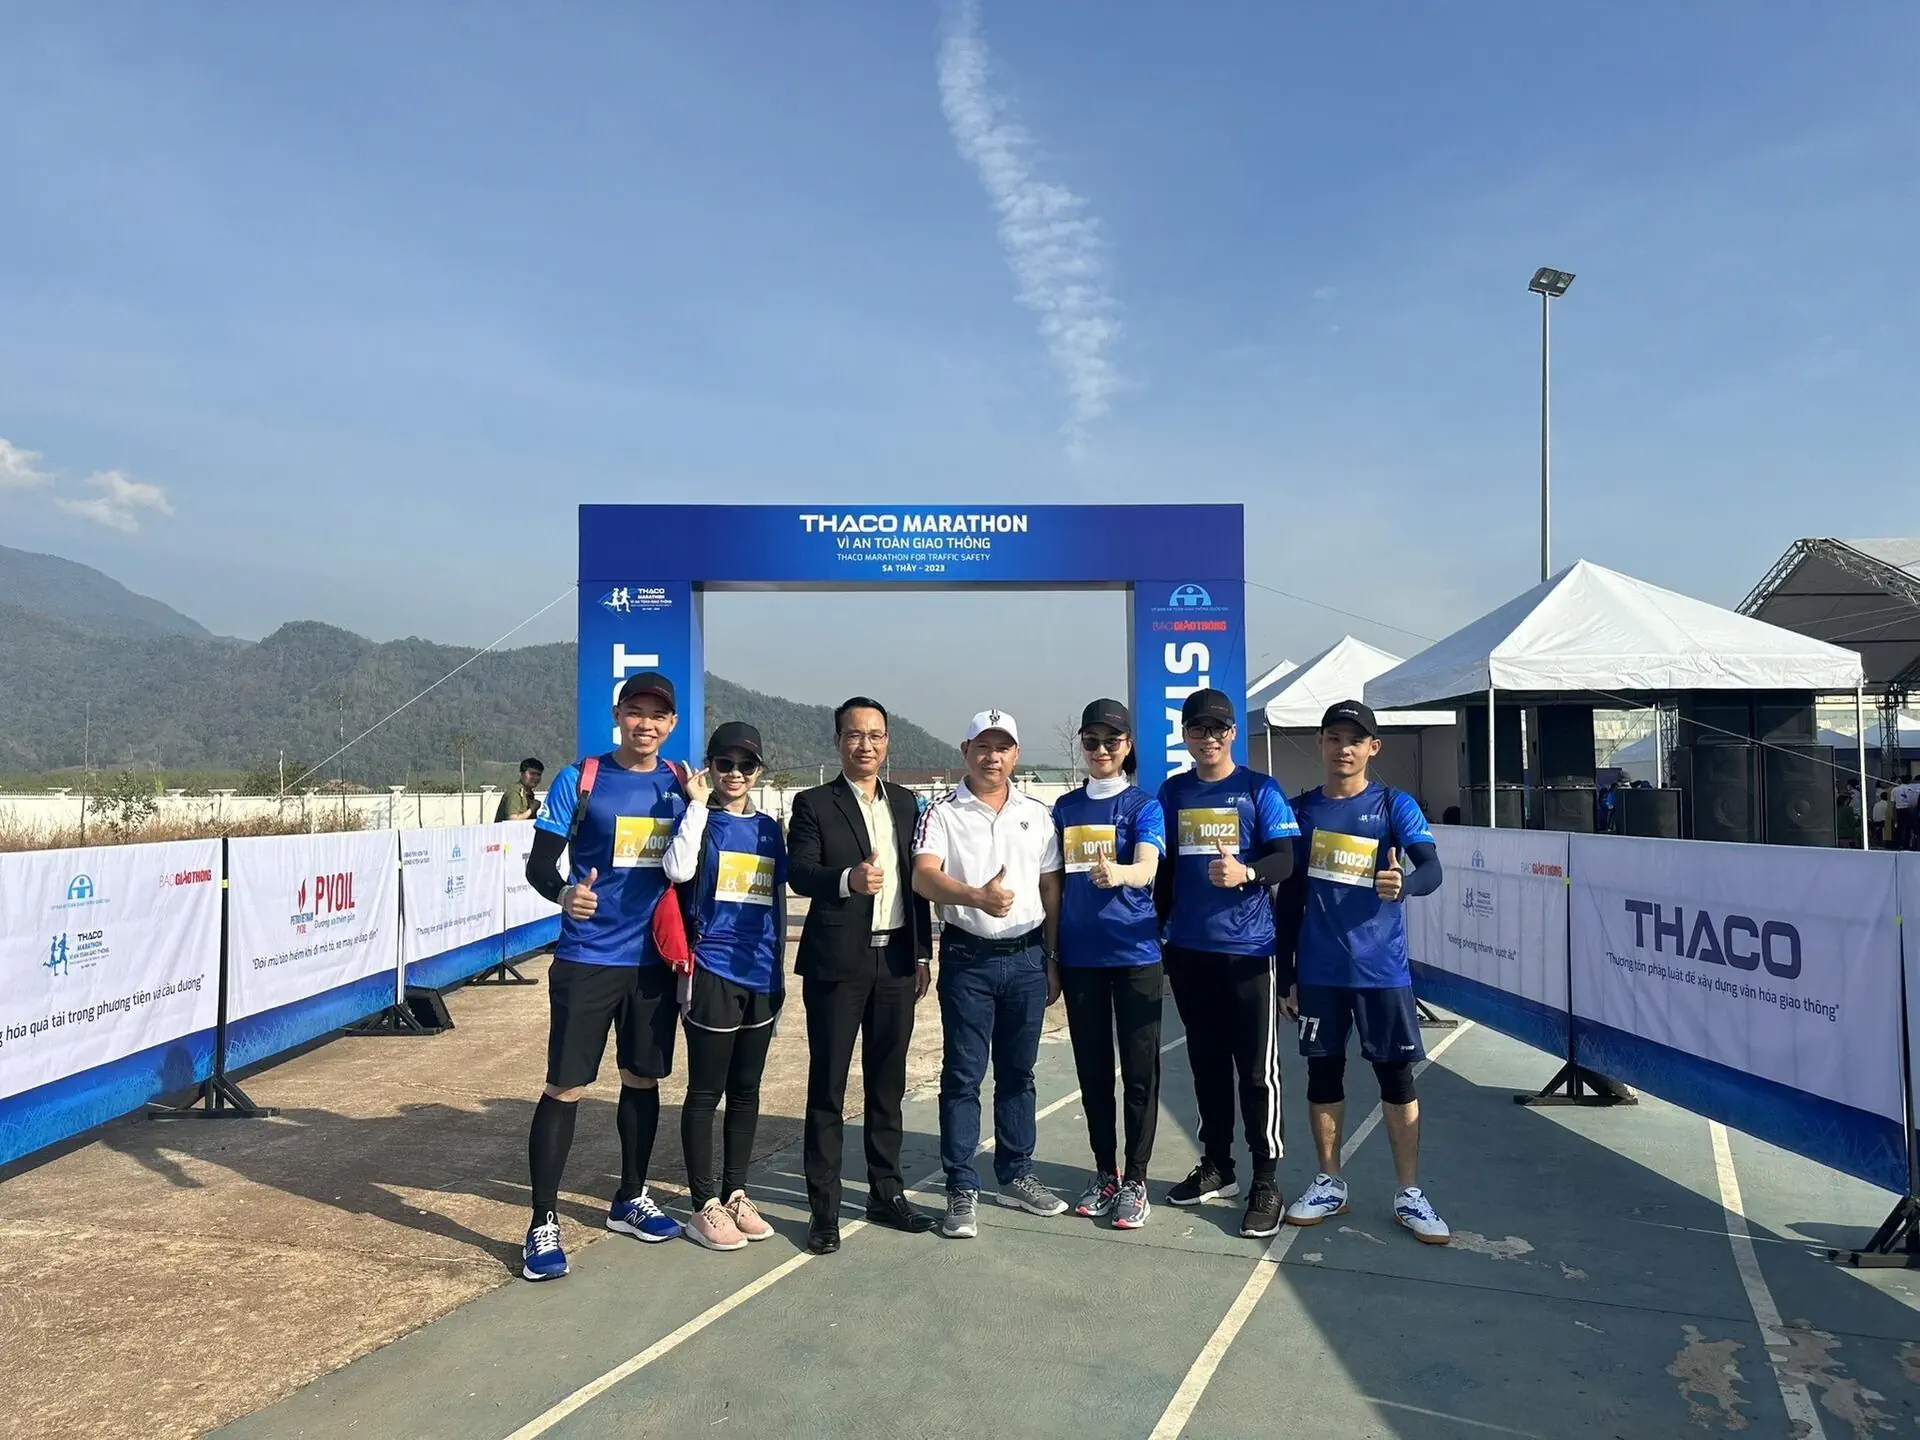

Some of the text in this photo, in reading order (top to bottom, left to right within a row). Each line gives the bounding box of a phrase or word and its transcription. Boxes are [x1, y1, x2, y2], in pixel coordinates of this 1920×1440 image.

[799, 514, 1028, 533] THACO MARATHON
[836, 535, 991, 549] VÌ AN TOÀN GIAO THÔNG
[836, 553, 991, 561] THACO MARATHON FOR TRAFFIC SAFETY
[882, 564, 893, 572] SA
[924, 564, 945, 572] 2023
[1199, 823, 1237, 837] 10022
[1333, 849, 1374, 869] 10020
[315, 872, 355, 915] PVOIL
[77, 929, 103, 942] THACO
[1624, 899, 1802, 980] THACO
[1648, 962, 1667, 981] pháp
[1685, 969, 1696, 985] để
[1697, 974, 1713, 992] xây
[1714, 977, 1738, 998] dựng
[1740, 984, 1757, 999] văn
[1758, 987, 1777, 1004] hóa
[1779, 993, 1801, 1010] giao
[1803, 997, 1840, 1022] thông"
[6, 1022, 27, 1041] hóa
[30, 1014, 49, 1038] quá
[51, 1010, 66, 1029] tải
[68, 1006, 95, 1025] trọng
[96, 997, 131, 1020] phương
[132, 989, 151, 1007] tiện
